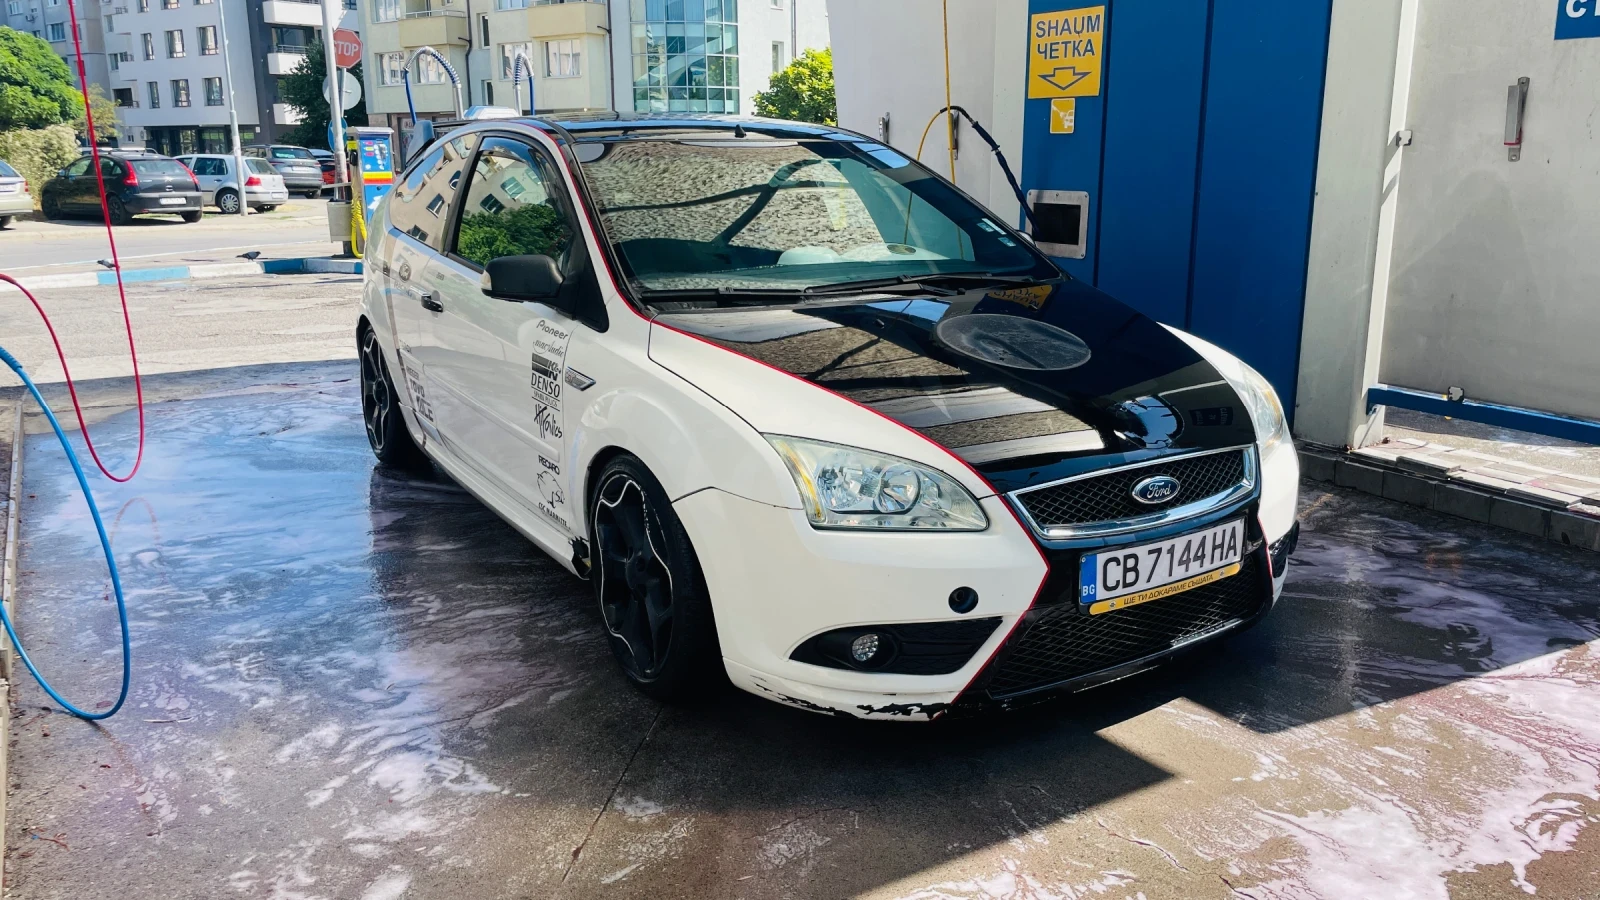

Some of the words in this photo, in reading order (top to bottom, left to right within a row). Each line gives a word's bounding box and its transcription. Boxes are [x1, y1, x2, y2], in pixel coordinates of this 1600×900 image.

[1035, 14, 1101, 38] SHAUM
[1037, 38, 1095, 60] ЧЕТКА
[536, 319, 569, 340] Pioneer
[531, 372, 561, 398] DENSO
[538, 455, 560, 475] RECARO
[1147, 481, 1171, 499] Ford
[1145, 534, 1207, 584] 7144
[1082, 583, 1095, 597] BG
